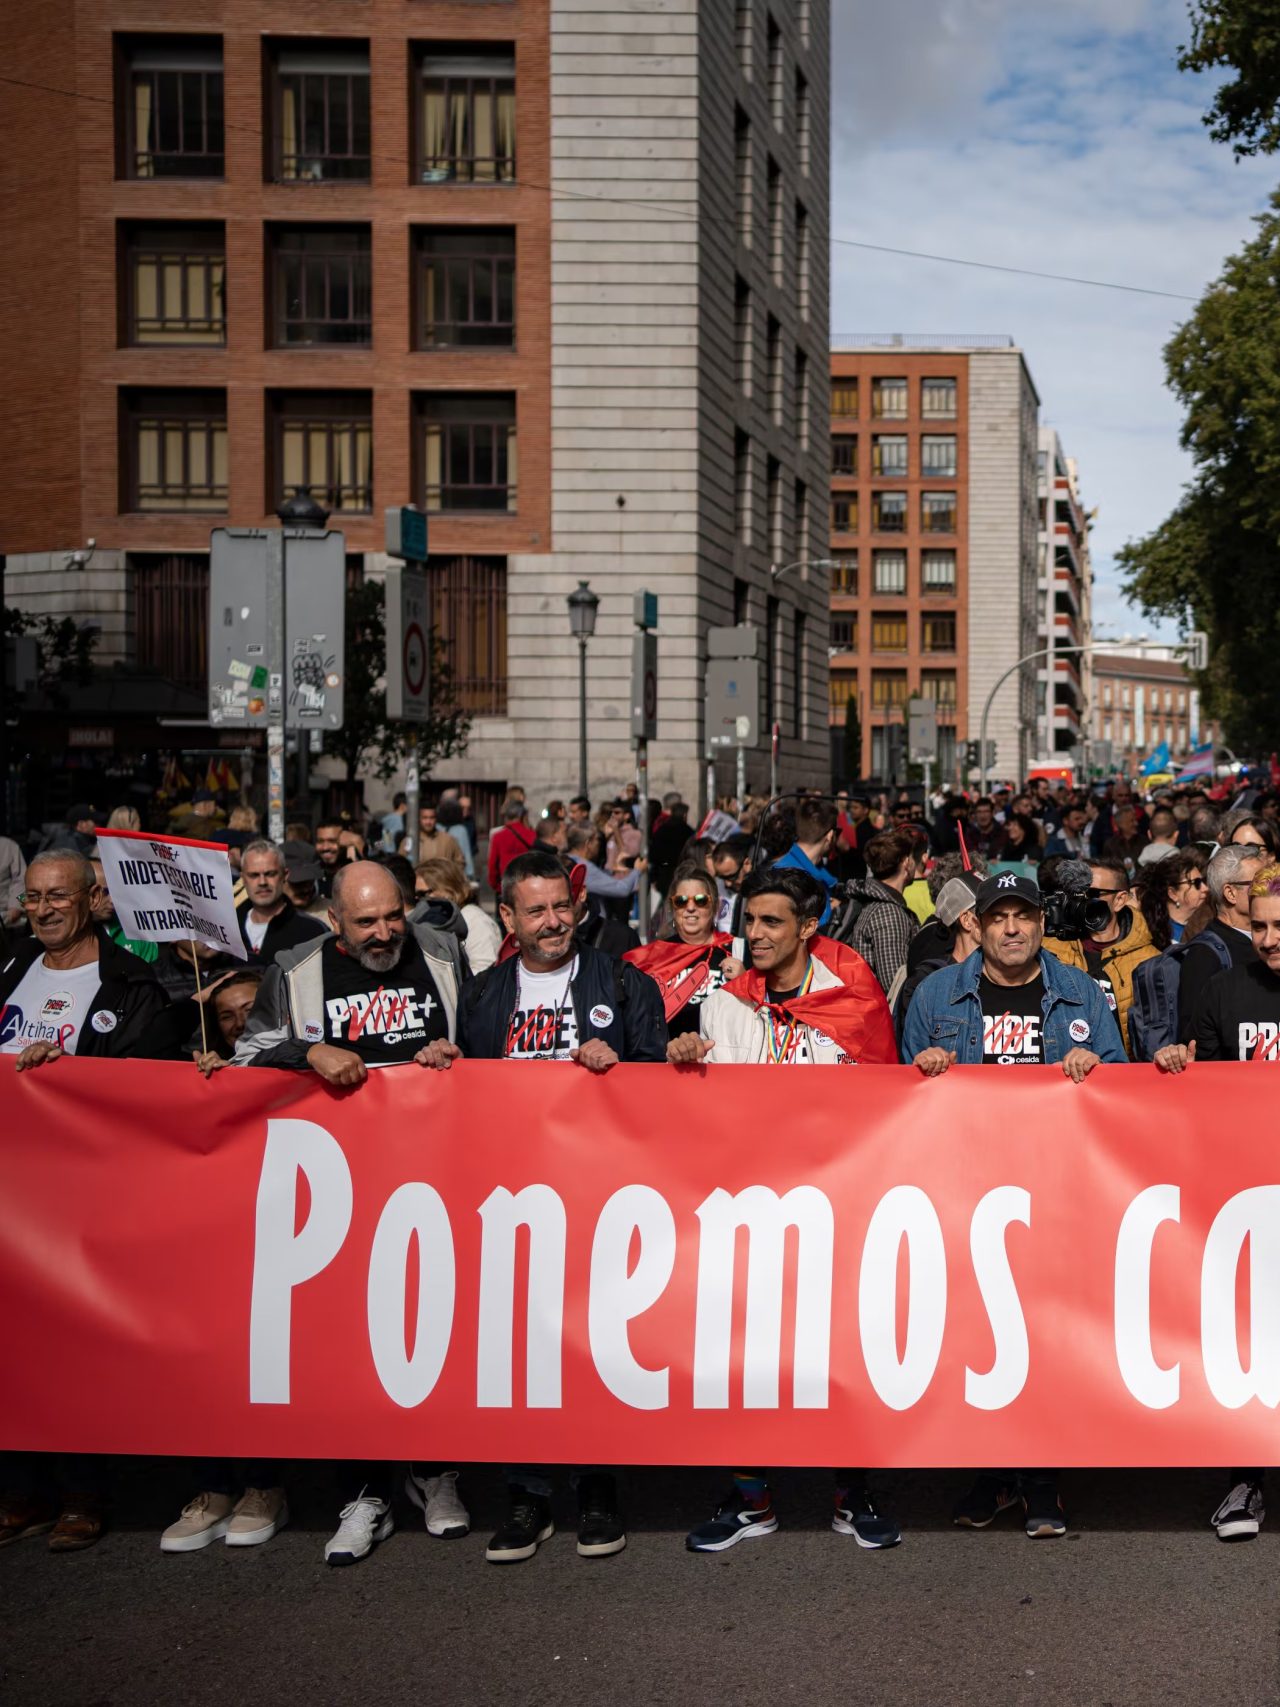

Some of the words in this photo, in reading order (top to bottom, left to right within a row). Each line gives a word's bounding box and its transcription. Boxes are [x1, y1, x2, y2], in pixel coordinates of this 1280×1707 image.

[119, 860, 218, 900] INDETECTABLE
[325, 987, 437, 1038] PRIDE+
[508, 1007, 578, 1053] RIDE
[983, 1015, 1043, 1054] RIDE
[249, 1118, 1032, 1411] Ponemos
